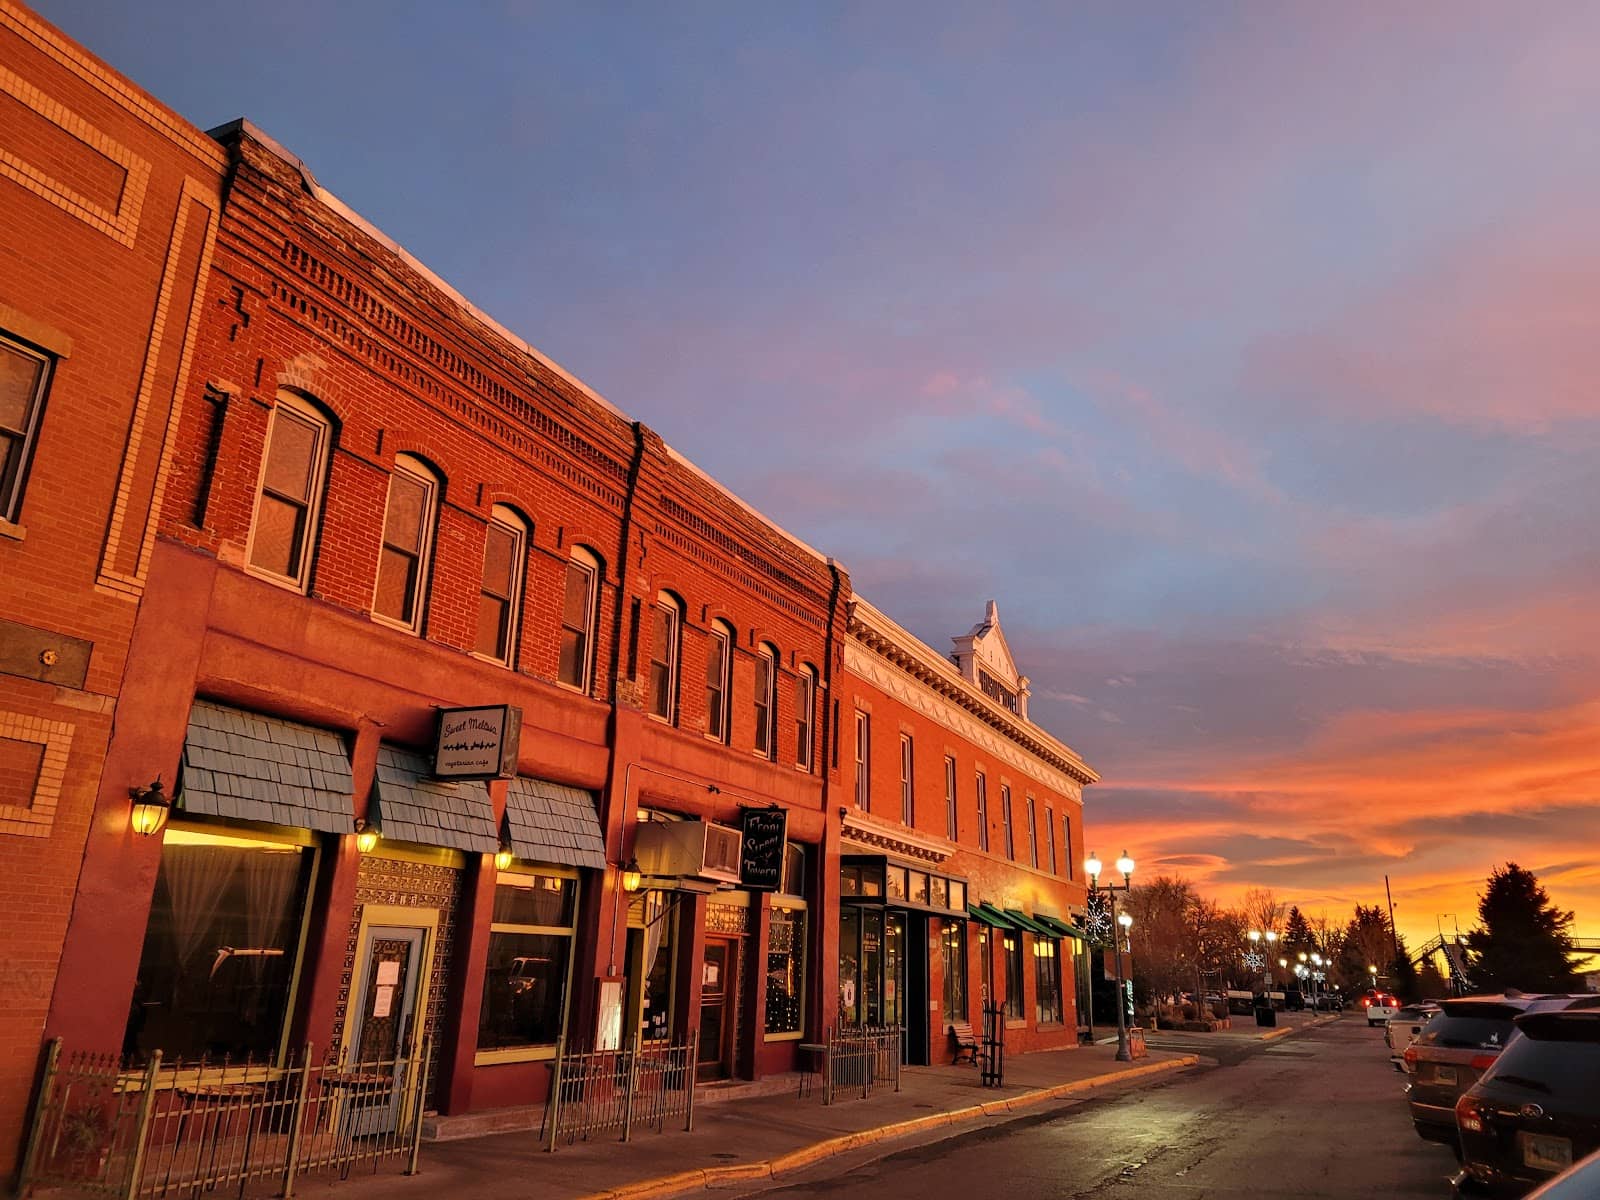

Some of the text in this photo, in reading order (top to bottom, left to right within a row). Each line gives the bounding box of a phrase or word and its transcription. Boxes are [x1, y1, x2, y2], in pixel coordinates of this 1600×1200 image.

[444, 721, 466, 737] Sweet
[748, 816, 779, 832] Front
[747, 835, 778, 852] Street
[744, 859, 777, 876] Tavern
